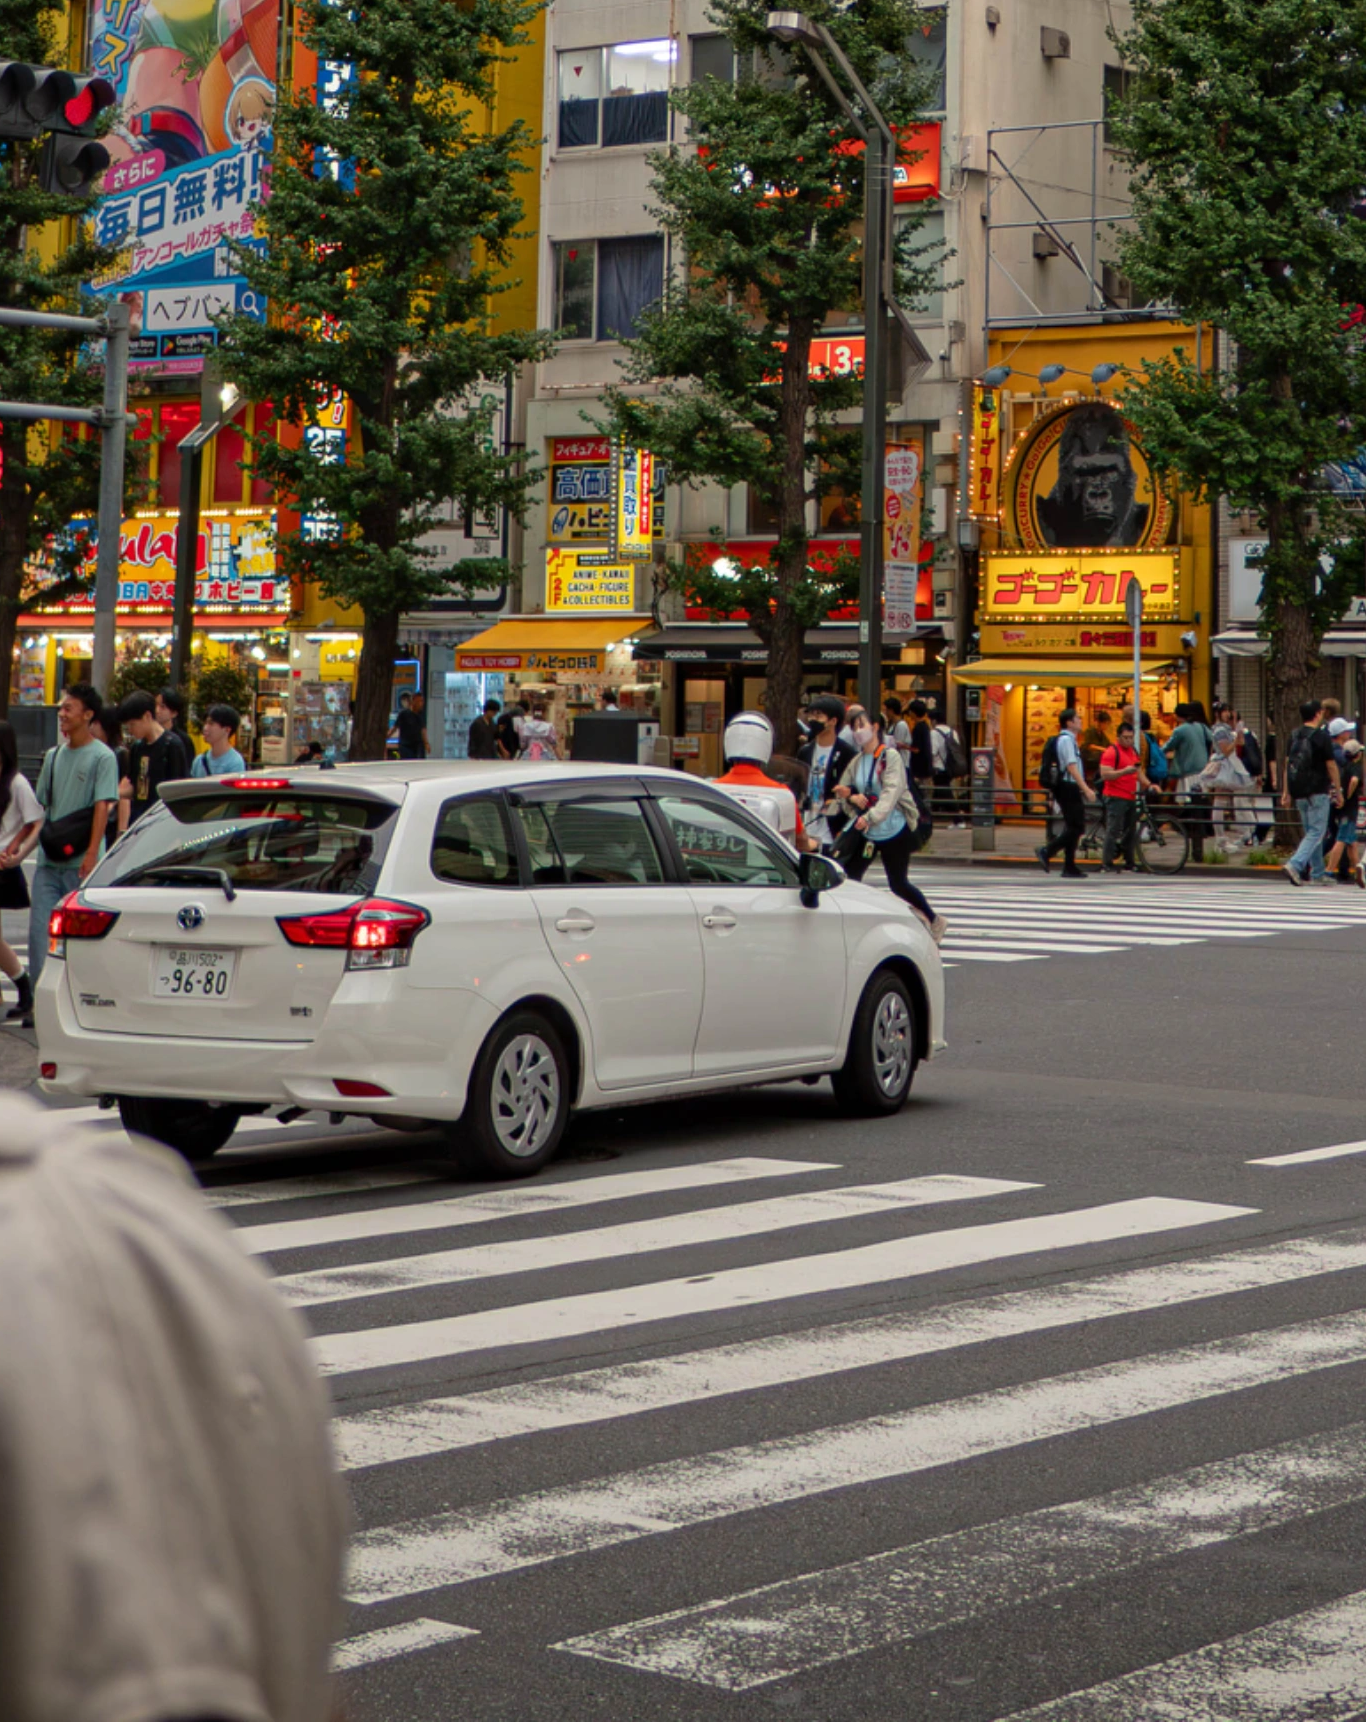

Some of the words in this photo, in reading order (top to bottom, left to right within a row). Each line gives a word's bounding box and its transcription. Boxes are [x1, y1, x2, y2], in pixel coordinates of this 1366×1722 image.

[113, 157, 156, 189] さらに
[98, 152, 261, 247] 毎日無料!
[153, 292, 231, 322] ヘブバン
[992, 566, 1170, 606] ゴーゴーカレー
[170, 968, 228, 996] 96-80
